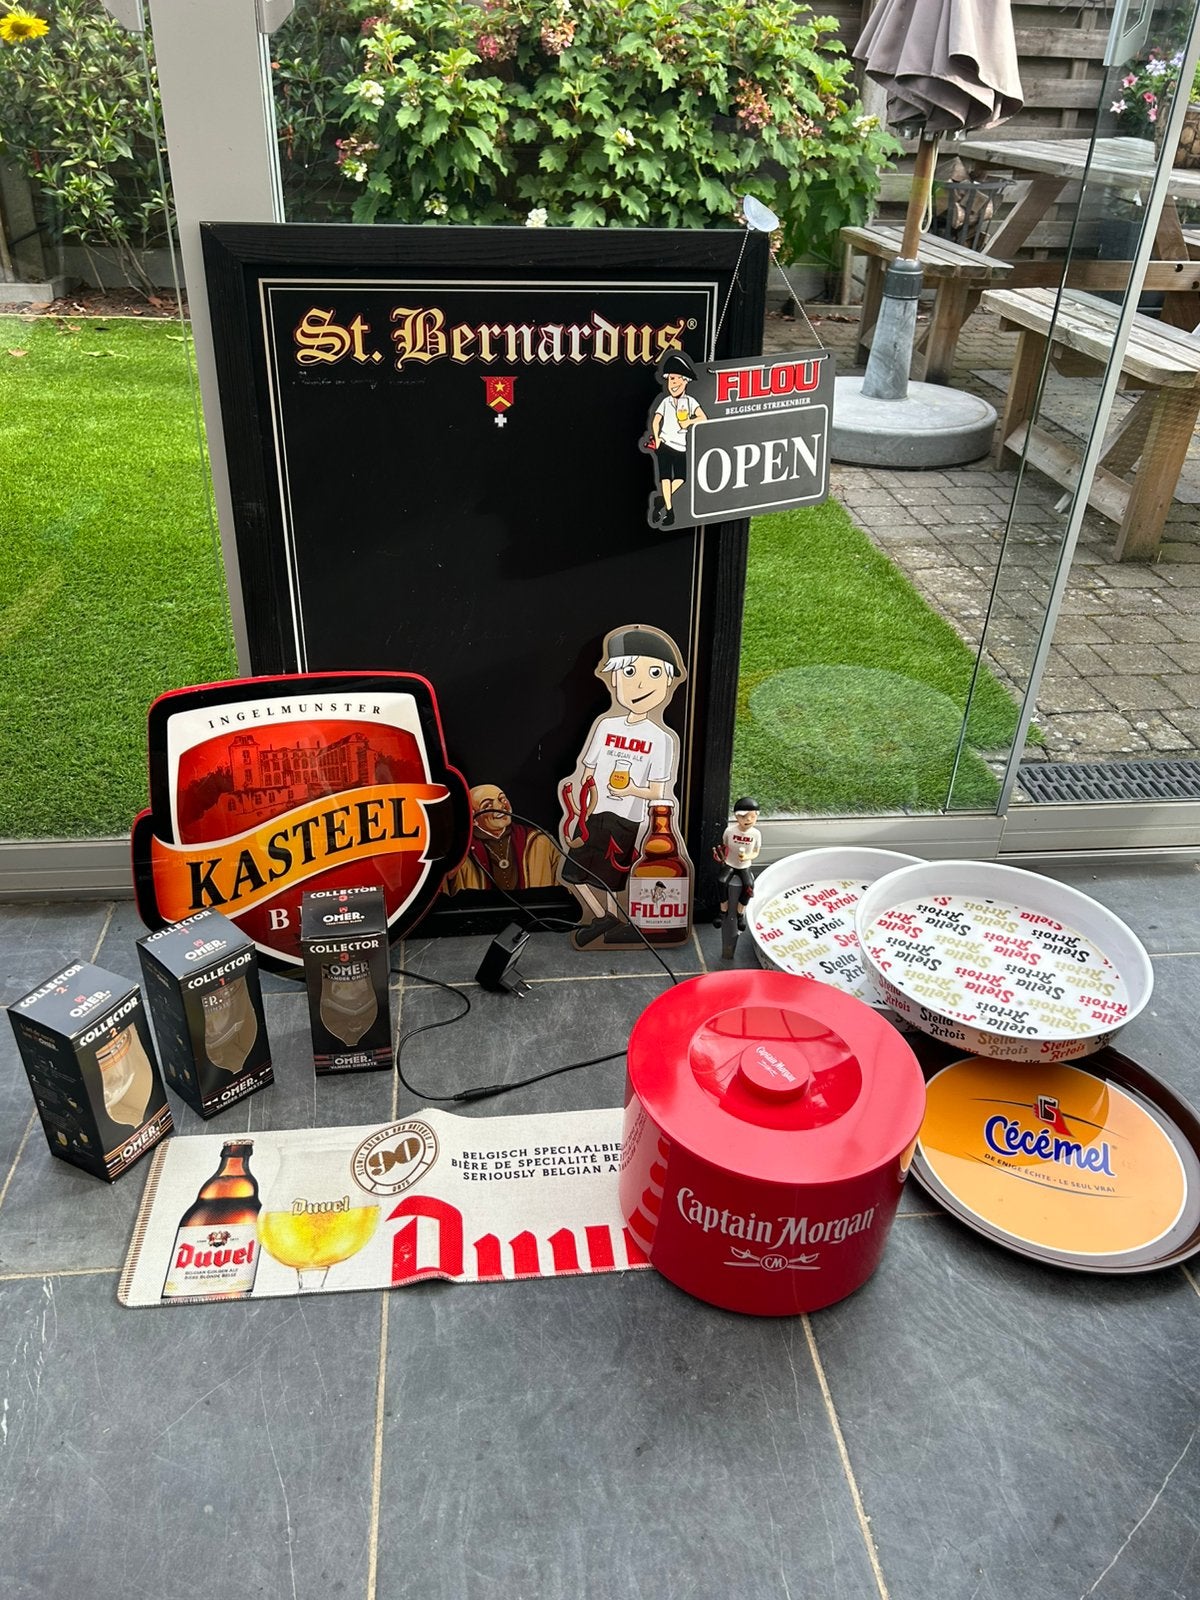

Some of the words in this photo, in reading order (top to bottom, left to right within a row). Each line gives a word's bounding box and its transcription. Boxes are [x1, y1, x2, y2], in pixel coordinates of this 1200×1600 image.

[295, 306, 383, 363] St.
[715, 361, 821, 404] FILOU
[725, 403, 762, 415] BELGISCH
[763, 397, 811, 411] STREKENBIER
[697, 433, 822, 494] OPEN
[208, 702, 382, 729] INGELMUNSTER
[604, 733, 653, 755] FILOU
[186, 796, 420, 910] KASTEEL
[310, 886, 377, 899] COLLECTOR
[803, 888, 839, 906] Stella
[822, 893, 859, 913] Artois
[322, 911, 365, 923] OMER.
[630, 901, 687, 918] FILOU
[916, 904, 965, 923] Artois
[146, 909, 212, 943] COLLECTOR
[787, 912, 825, 931] Stella
[807, 917, 845, 940] Artois
[877, 918, 923, 939] Stella
[925, 917, 972, 936] Stella
[309, 939, 380, 954] COLLECTOR
[770, 937, 810, 958] Stella
[886, 936, 936, 957] Artois
[983, 931, 1034, 952] Artois
[1031, 928, 1081, 948] Artois
[184, 939, 227, 960] OMER.
[791, 943, 831, 966] Artois
[894, 950, 943, 971] Stella
[993, 945, 1043, 966] Stella
[1042, 941, 1091, 963] Stella
[187, 951, 253, 990] COLLECTOR
[818, 953, 858, 975] Stella
[1004, 962, 1057, 985] Artois
[19, 964, 84, 1008] COLLECTOR
[954, 966, 1007, 988] Artois
[964, 981, 1015, 1004] Stella
[1014, 978, 1066, 1001] Stella
[69, 988, 111, 1018] OMER.
[885, 991, 911, 1013] Artois
[975, 1001, 1030, 1024] Artois
[1078, 994, 1128, 1017] Artois
[78, 995, 140, 1047] COLLECTOR
[919, 1006, 954, 1027] Stella
[929, 1023, 966, 1041] Artois
[334, 1055, 372, 1066] OMER.
[988, 1044, 1029, 1057] Artois
[1049, 1043, 1087, 1062] Artois
[220, 1077, 258, 1101] OMER.
[123, 1124, 161, 1158] OMER.
[983, 1113, 1117, 1178] Cécémel
[368, 1137, 421, 1177] 90
[451, 1157, 488, 1171] BIÈRE
[494, 1160, 512, 1170] DE
[518, 1153, 598, 1168] SPECIALITÉ
[462, 1148, 528, 1160] BELGISCH
[984, 1153, 996, 1162] DE
[463, 1168, 536, 1181] SERIOUSLY
[542, 1164, 602, 1177] BELGIAN
[290, 1195, 351, 1217] Duvel
[676, 1186, 774, 1244] Captain
[766, 1206, 876, 1250] Morgan
[175, 1239, 256, 1269] Duvel
[763, 1256, 784, 1270] CM
